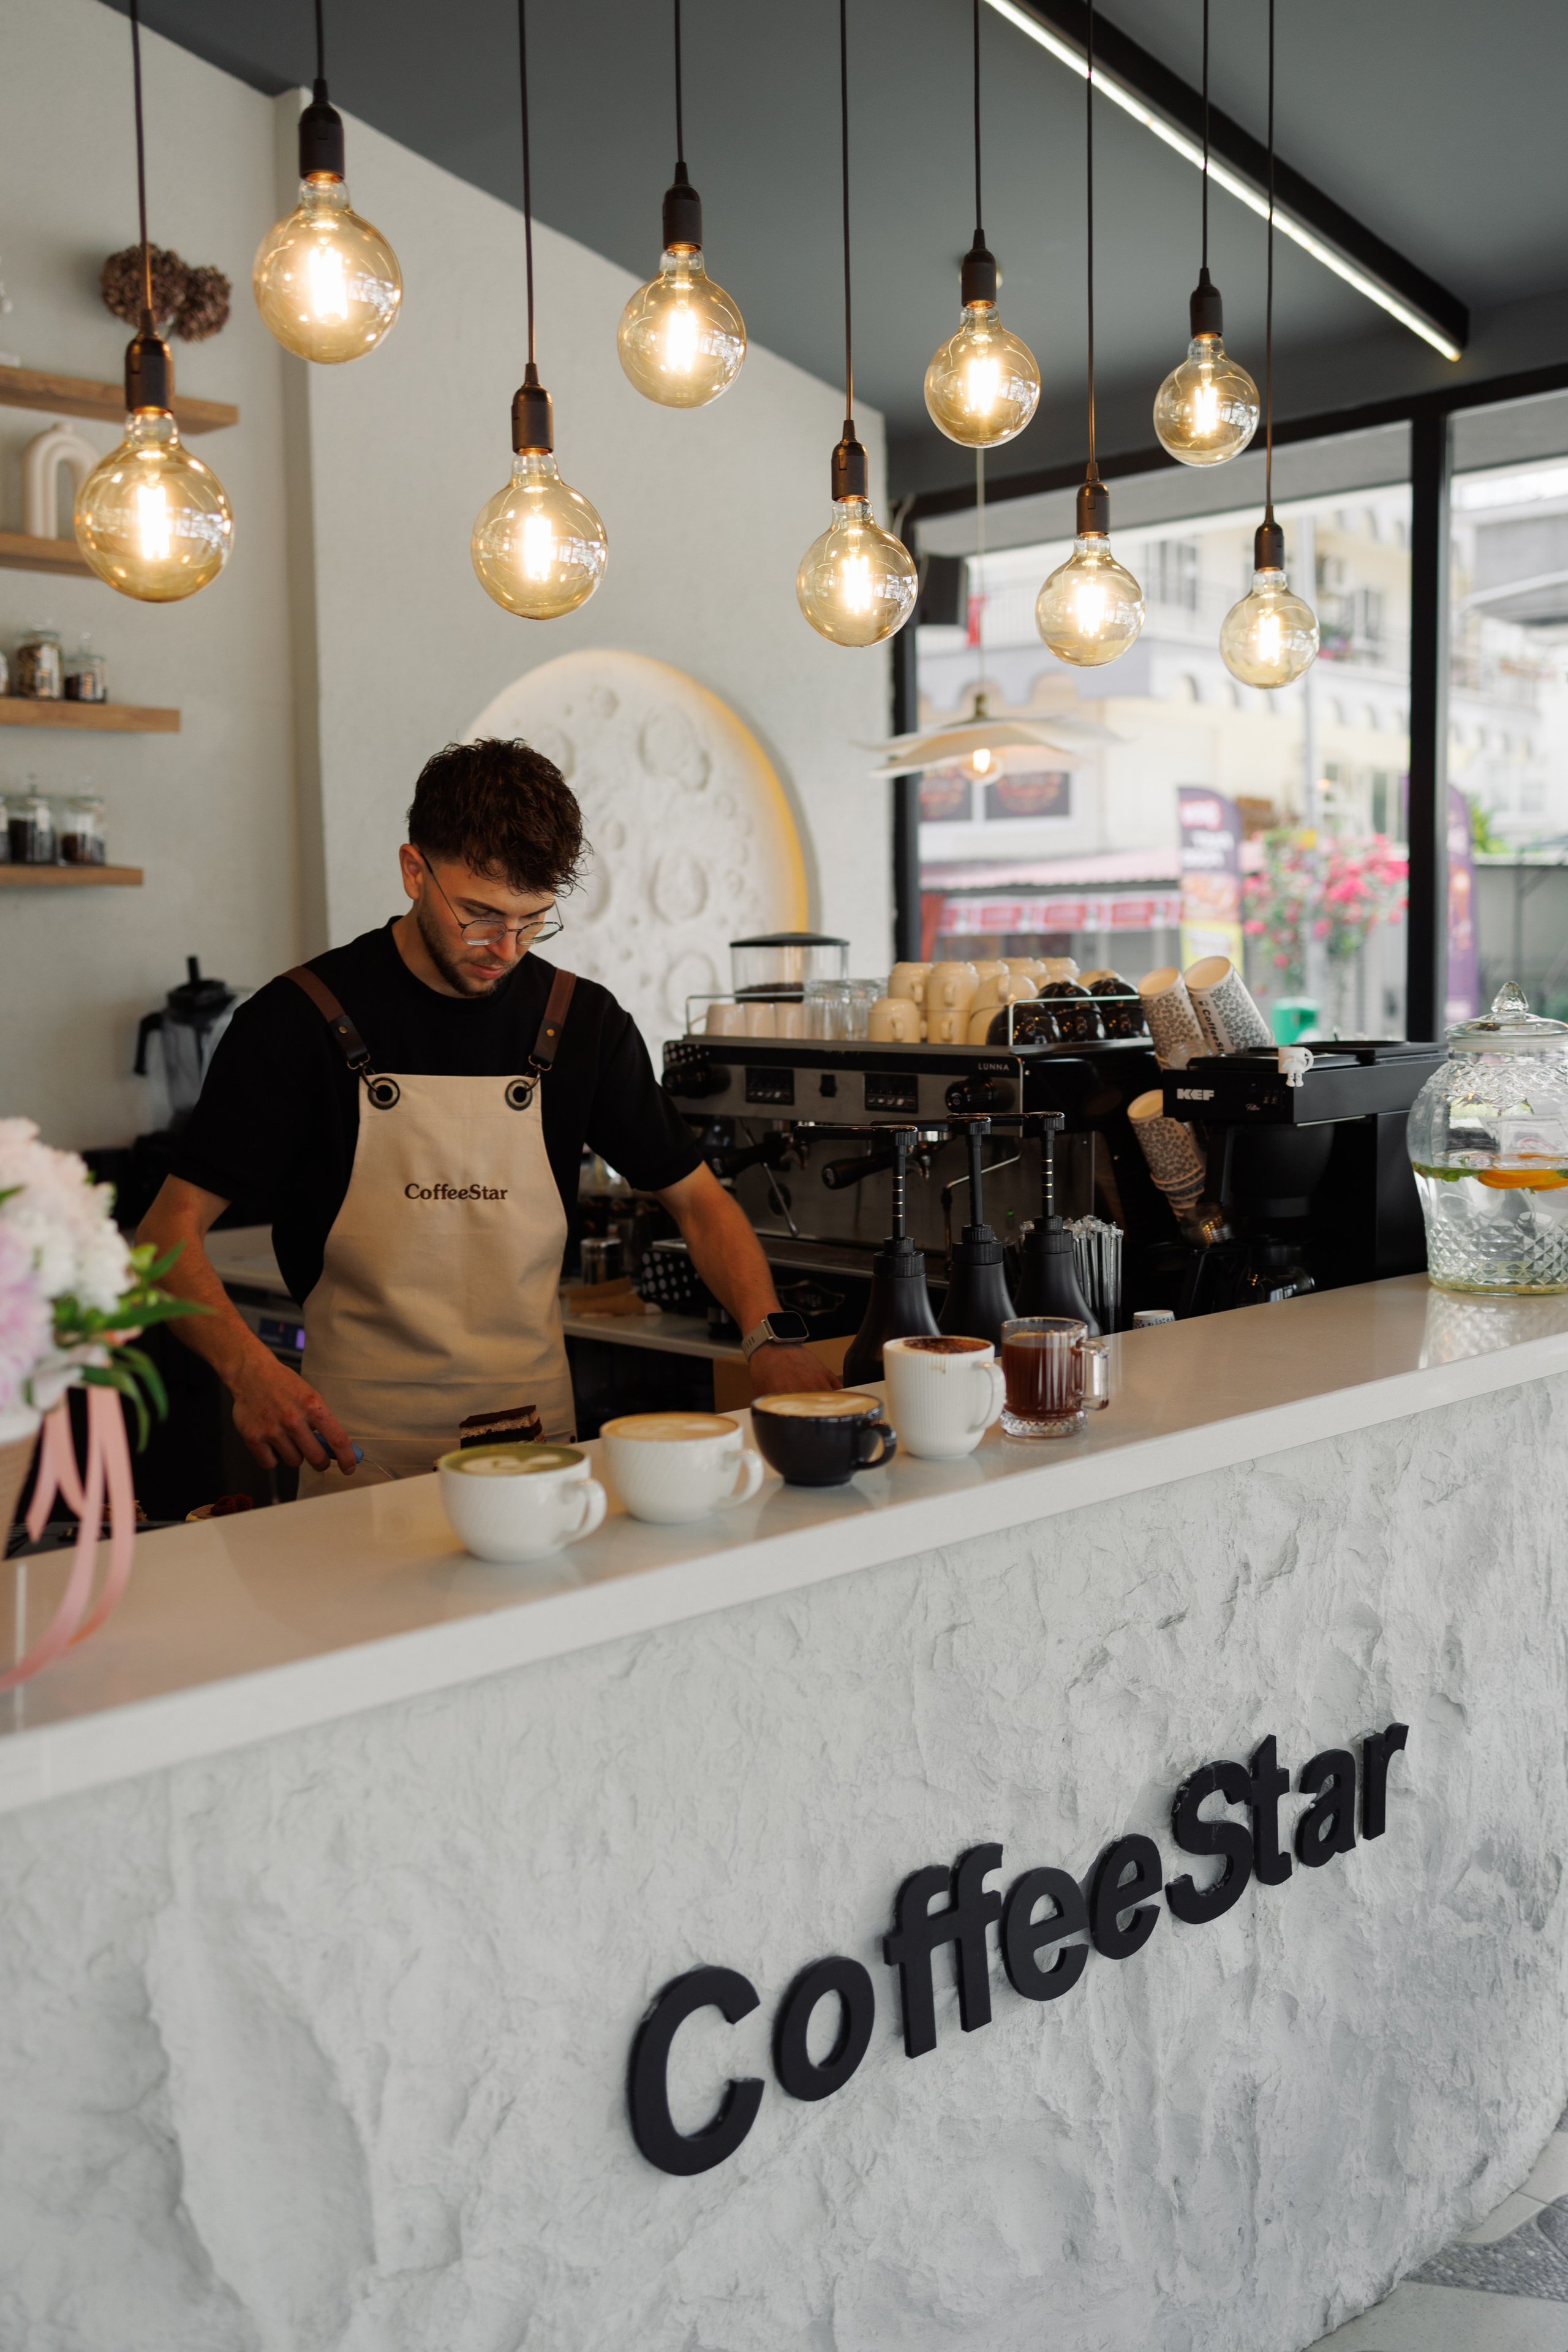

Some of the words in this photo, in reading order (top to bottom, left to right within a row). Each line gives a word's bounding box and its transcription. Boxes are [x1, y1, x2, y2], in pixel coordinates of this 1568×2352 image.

[1202, 1009, 1224, 1054] CoffeeSt
[1177, 1088, 1214, 1101] KEF
[404, 1183, 508, 1200] CoffeeStar
[627, 1722, 1409, 2176] CoffeeStar
